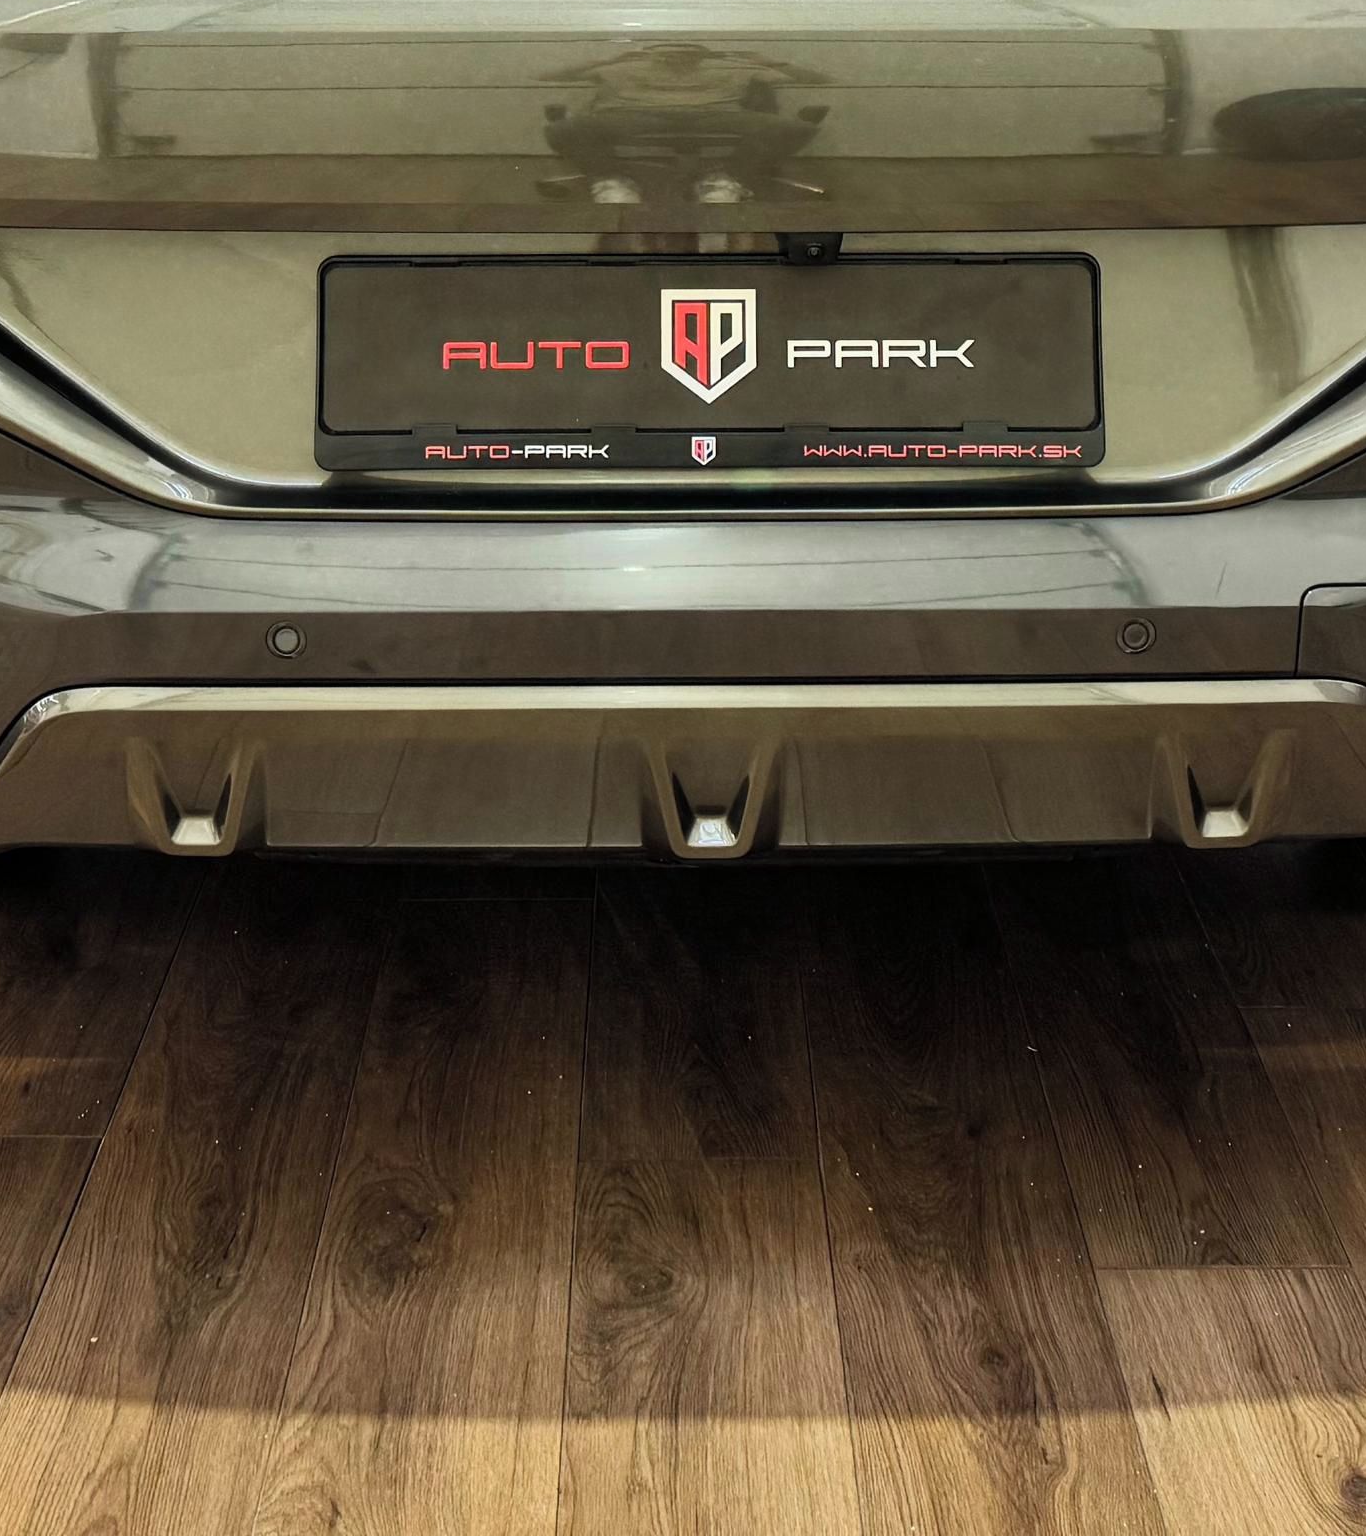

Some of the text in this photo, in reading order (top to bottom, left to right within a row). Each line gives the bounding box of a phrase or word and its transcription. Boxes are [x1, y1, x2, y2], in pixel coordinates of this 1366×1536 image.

[442, 340, 630, 370] AUTO
[786, 339, 975, 369] PARK
[424, 444, 610, 460] AUTO-PARK
[803, 444, 1083, 459] WWW.AUTO-PARK.SK
